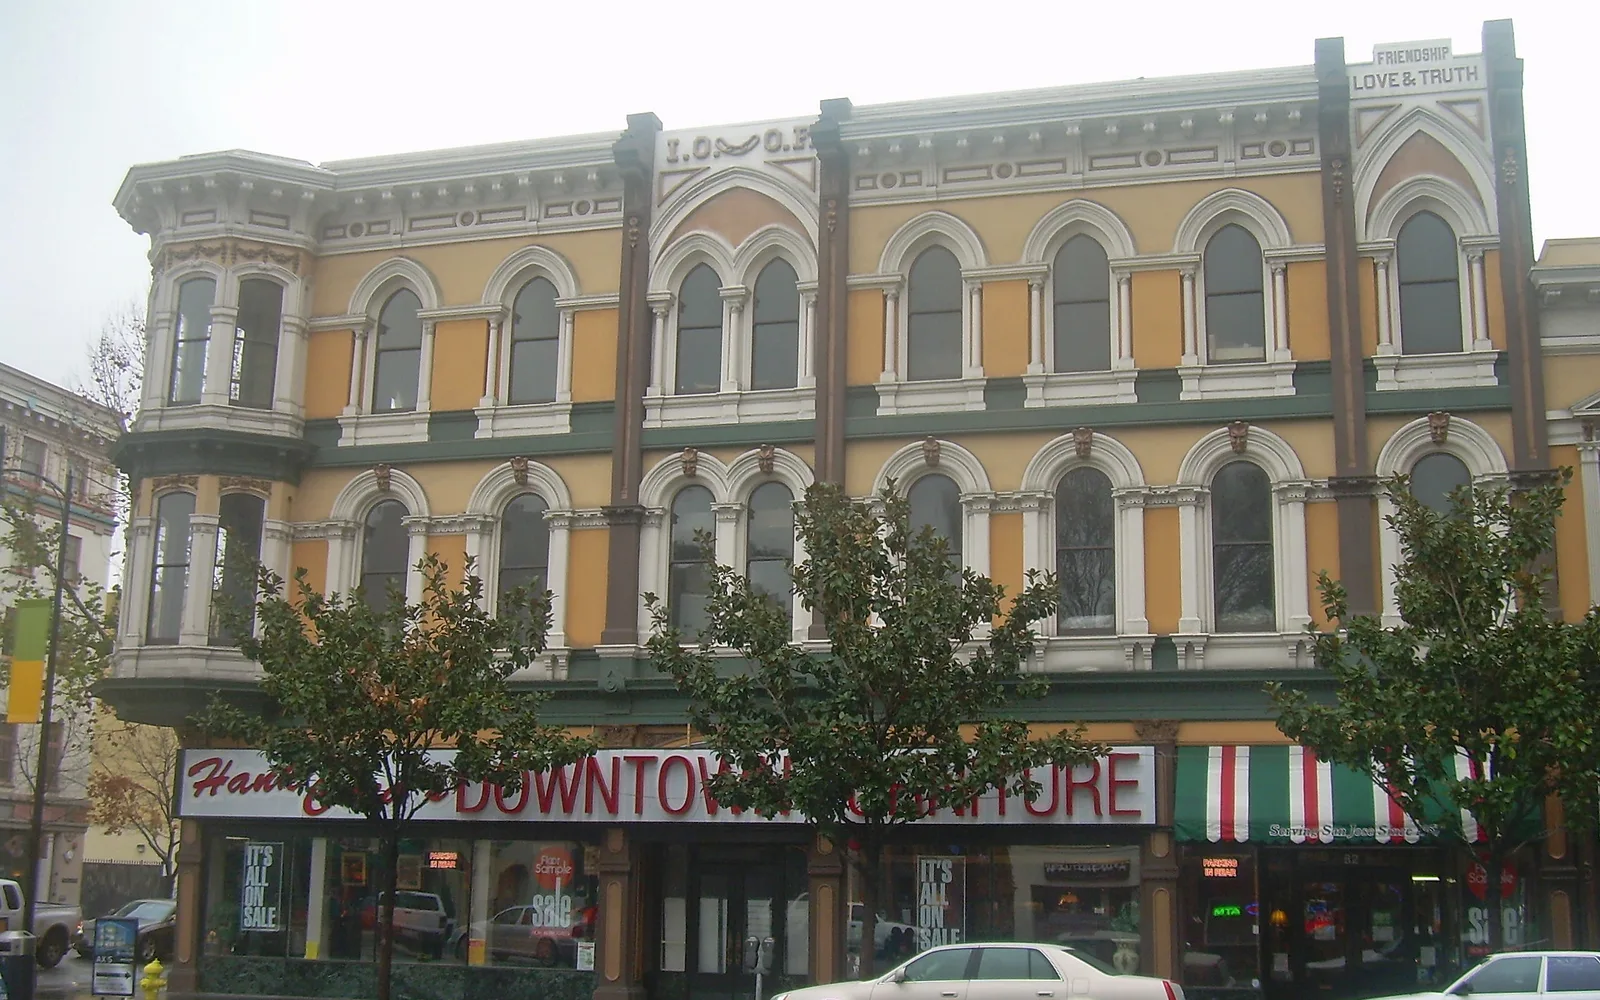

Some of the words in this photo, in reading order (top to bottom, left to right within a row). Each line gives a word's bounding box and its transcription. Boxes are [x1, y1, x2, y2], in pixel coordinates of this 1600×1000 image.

[1377, 46, 1450, 65] FRIENDSHIP
[1353, 71, 1400, 91] LOVE
[1402, 70, 1416, 87] &
[1419, 66, 1478, 84] TRUTH
[247, 845, 273, 867] IT'S
[535, 860, 572, 874] Sample
[245, 865, 269, 887] ALL
[920, 859, 953, 883] IT'S
[244, 886, 265, 907] ON
[920, 882, 949, 906] ALL
[243, 906, 276, 927] SALE
[920, 905, 944, 928] ON
[920, 928, 960, 950] SALE
